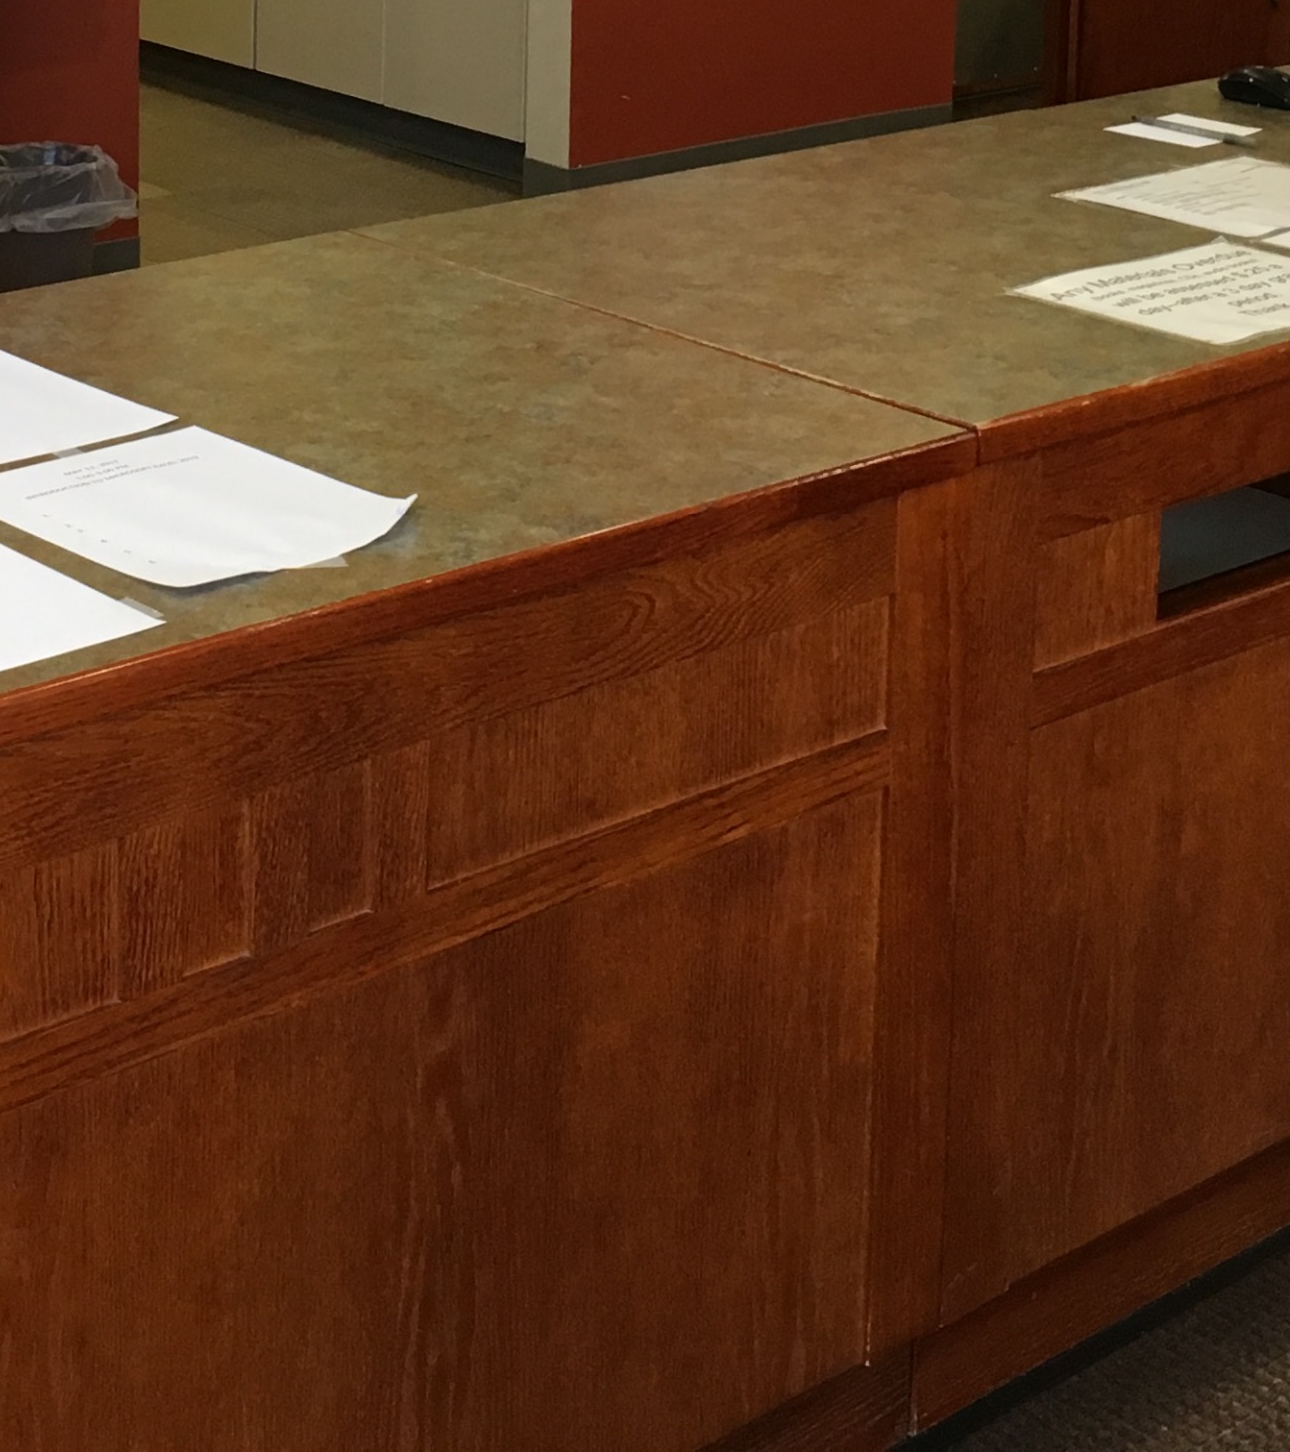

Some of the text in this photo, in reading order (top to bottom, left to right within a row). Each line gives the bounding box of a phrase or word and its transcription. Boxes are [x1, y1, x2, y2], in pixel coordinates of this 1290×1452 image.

[1050, 250, 1251, 302] Any Materials Overdue
